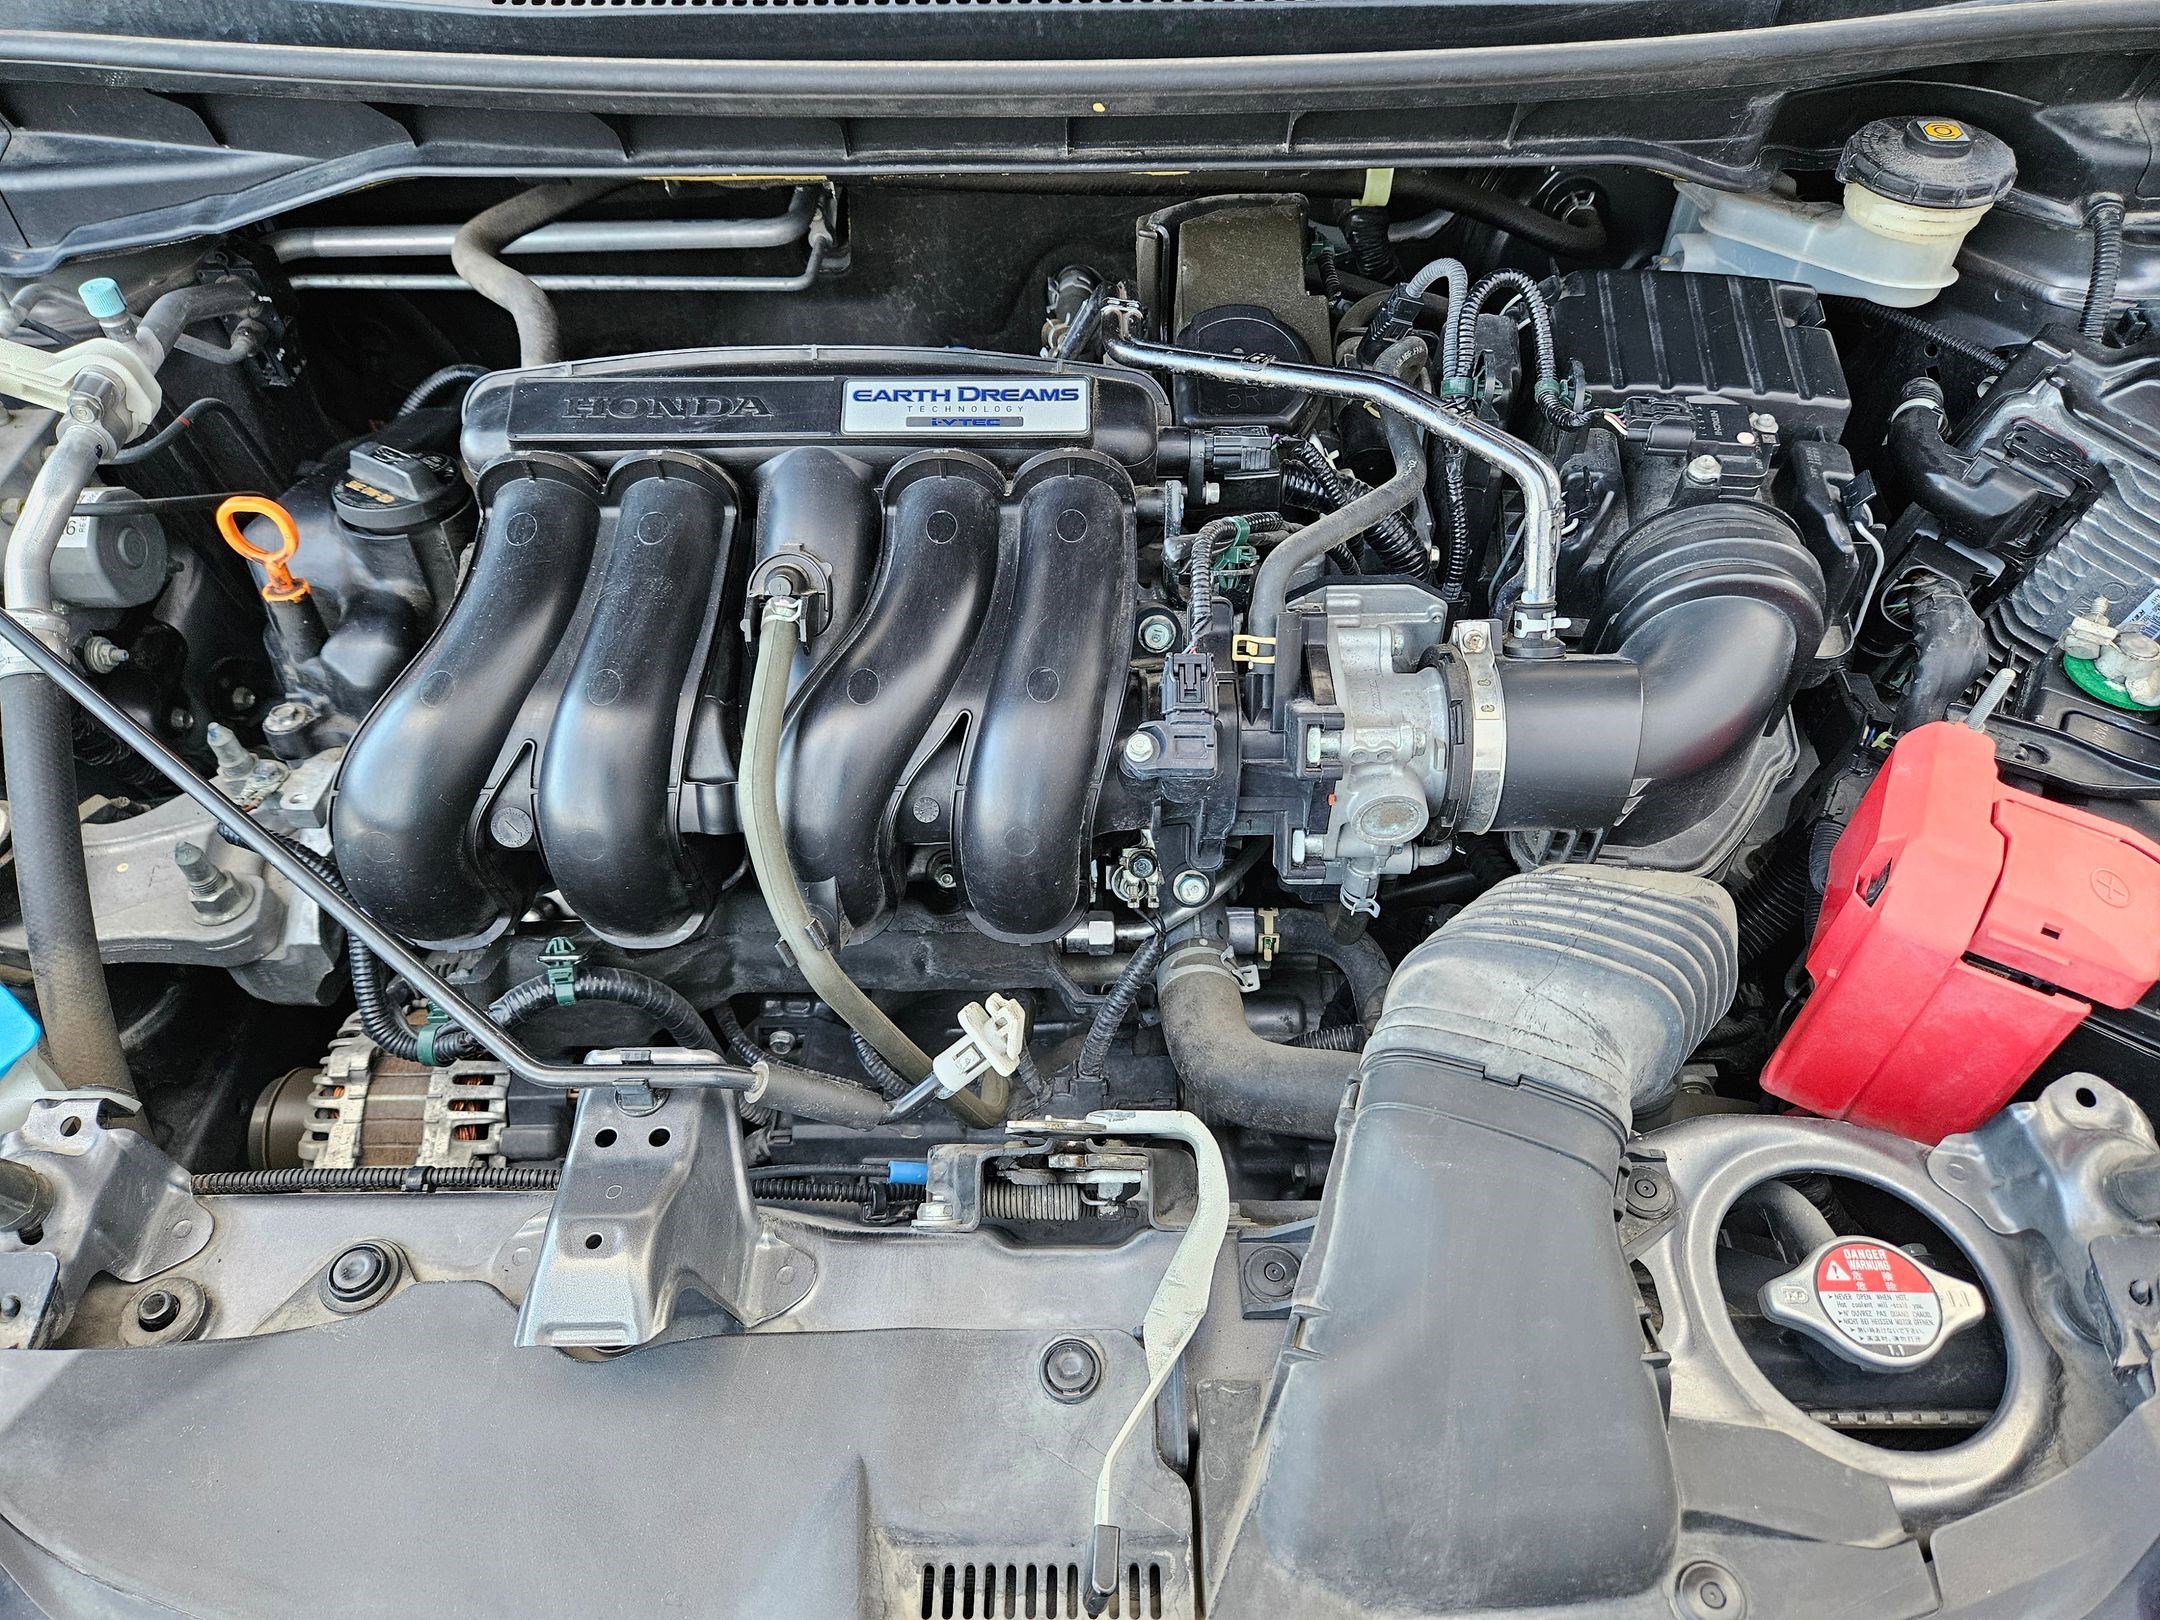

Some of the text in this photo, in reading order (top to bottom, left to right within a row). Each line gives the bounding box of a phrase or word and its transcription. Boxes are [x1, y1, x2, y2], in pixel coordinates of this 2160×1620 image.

[852, 386, 1079, 402] EARTH DREAMS
[562, 396, 774, 419] HONDA
[907, 405, 1024, 413] TECHNOLOGY
[931, 417, 1001, 427] i-VTEC
[1843, 1249, 1886, 1259] DANGER
[1849, 1260, 1891, 1271] WARNUNG
